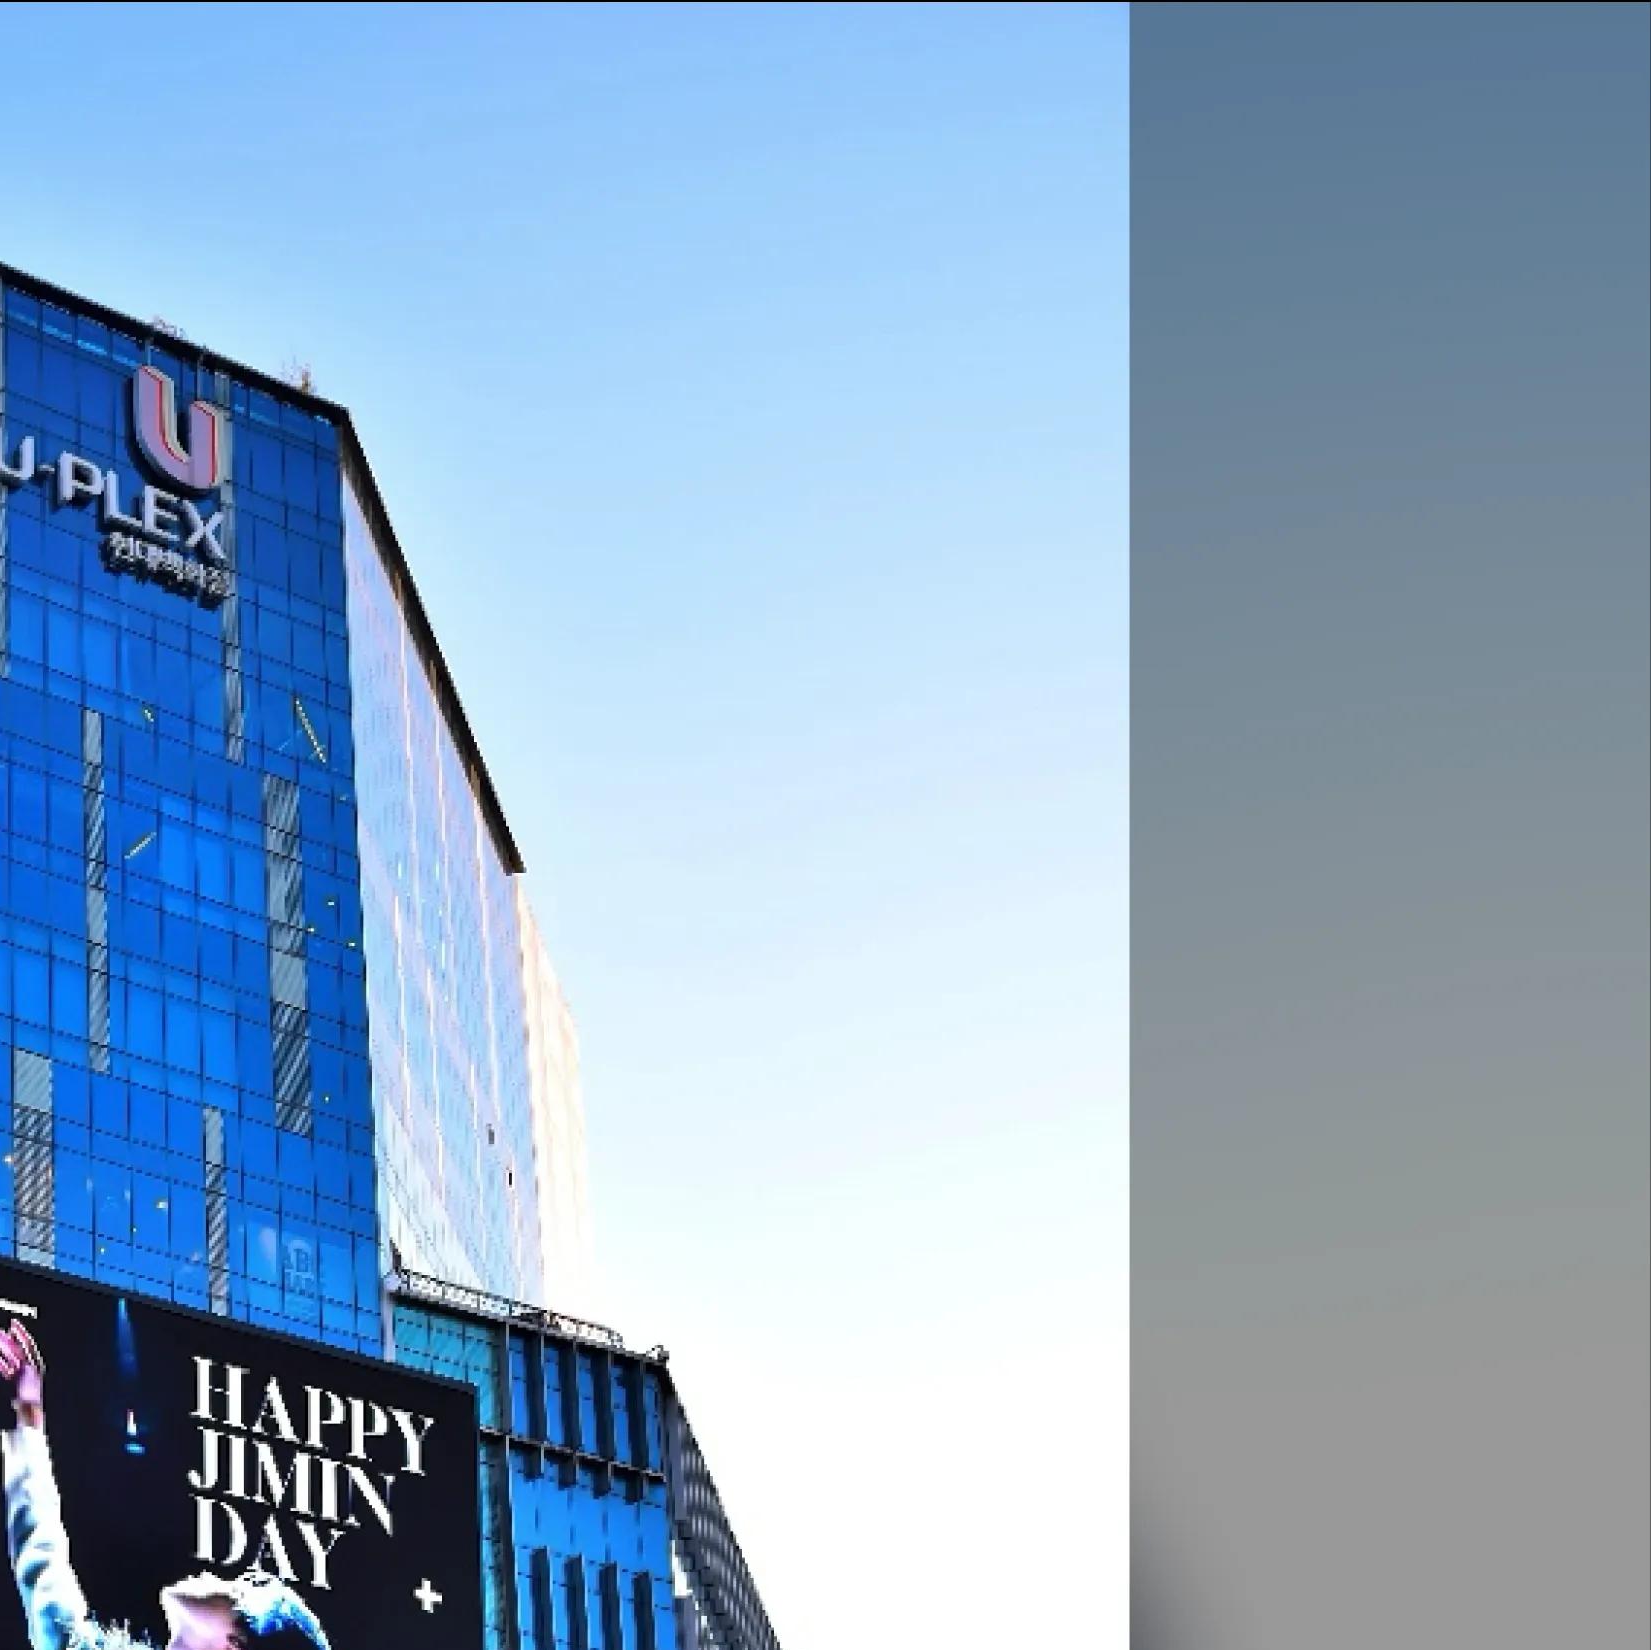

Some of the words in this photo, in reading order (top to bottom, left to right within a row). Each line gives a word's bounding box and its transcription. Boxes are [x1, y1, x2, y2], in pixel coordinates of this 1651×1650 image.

[192, 1356, 435, 1476] HAPPY
[188, 1425, 396, 1538] JIMIN
[191, 1495, 347, 1590] DAY
